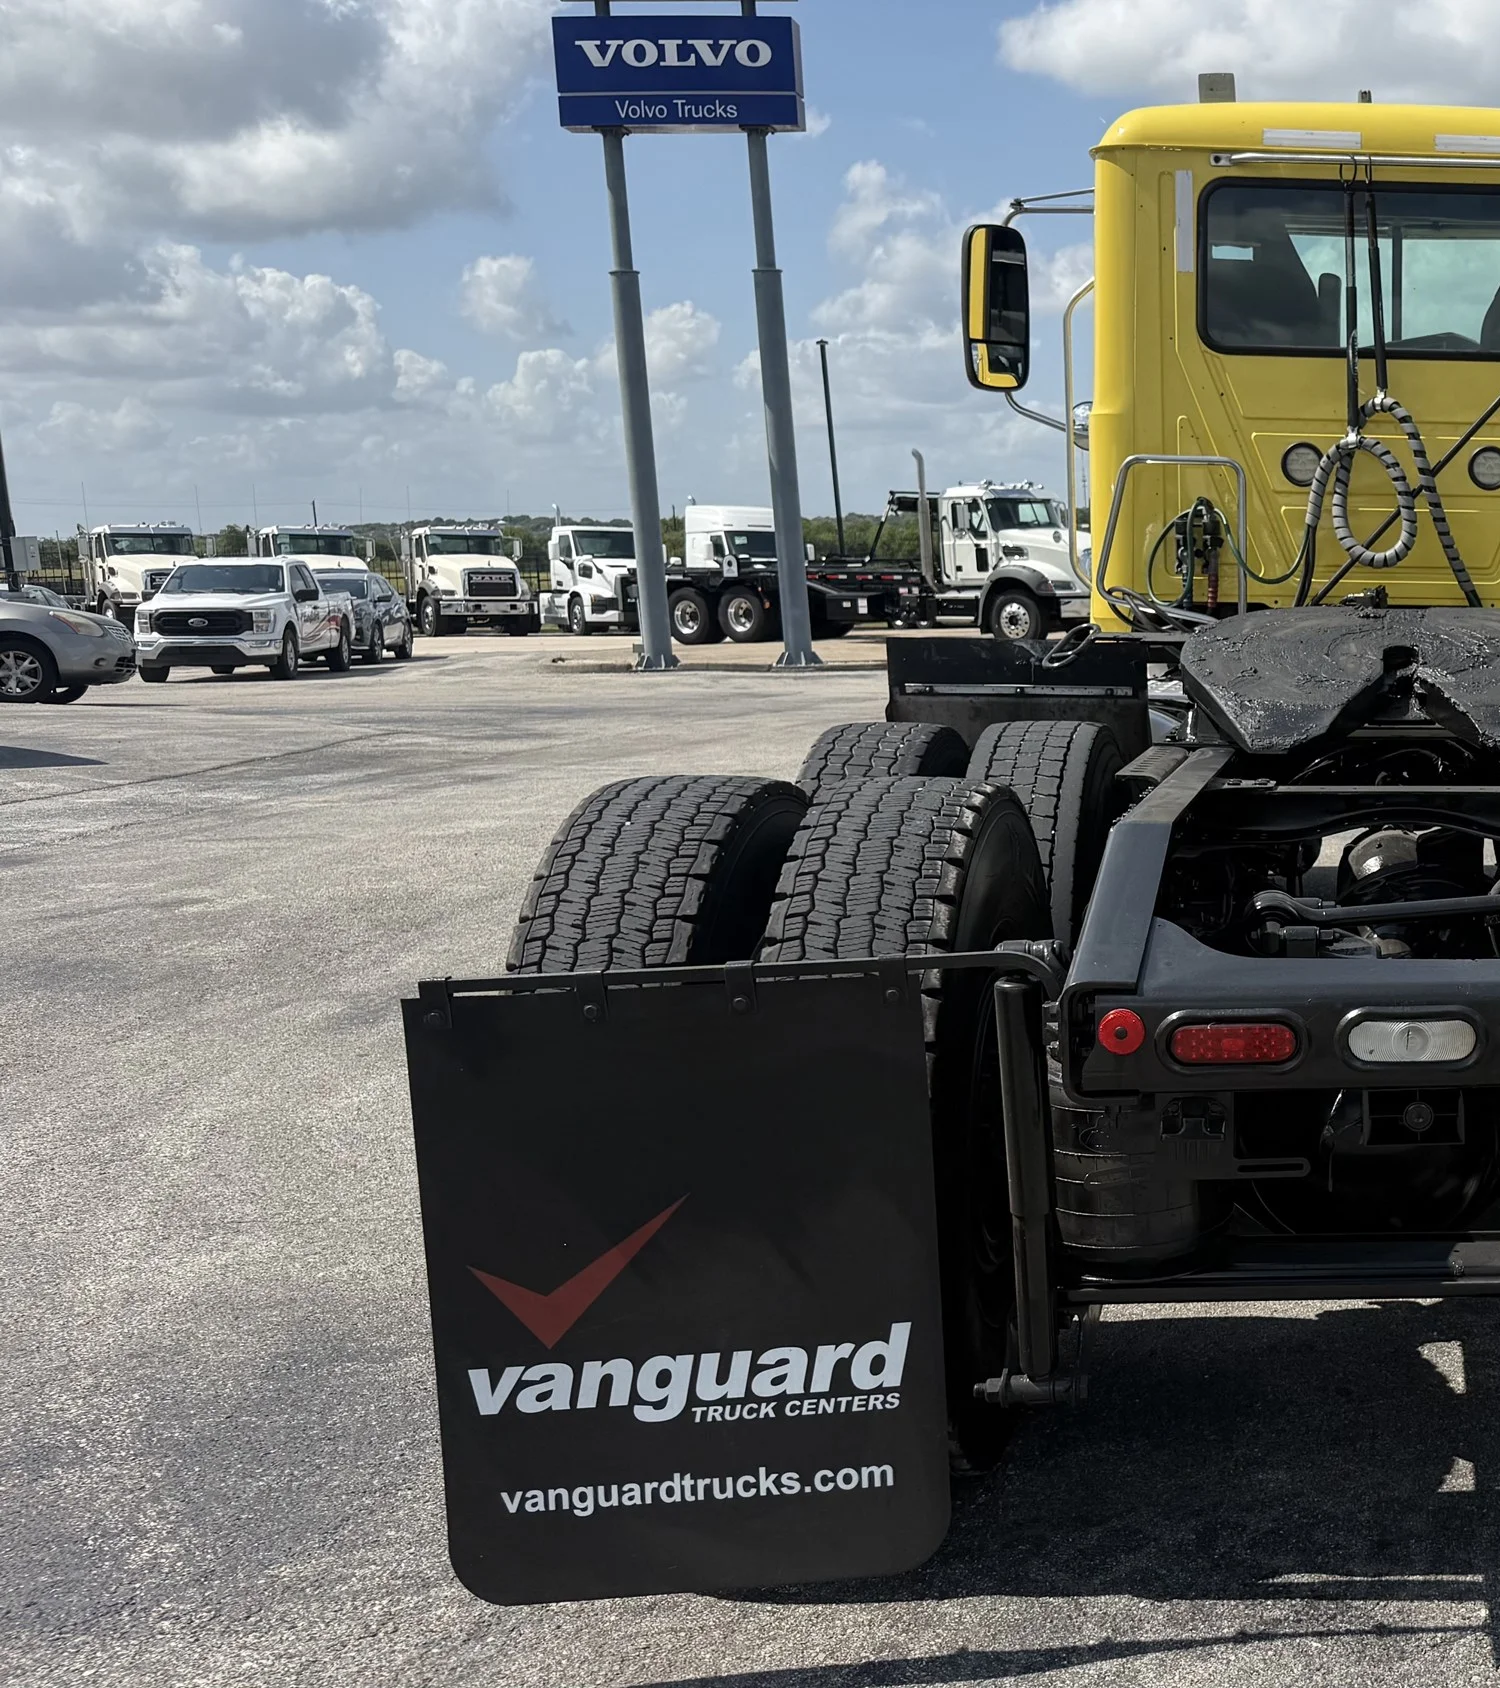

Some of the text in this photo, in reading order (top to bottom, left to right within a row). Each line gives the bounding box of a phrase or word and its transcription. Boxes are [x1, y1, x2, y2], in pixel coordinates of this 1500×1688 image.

[575, 39, 772, 67] VOLVO
[615, 99, 738, 119] Volvo Trucks
[467, 1321, 912, 1423] vanguard
[691, 1392, 901, 1423] TRUCK CENTERS
[500, 1463, 895, 1517] vanguardtrucks.com
